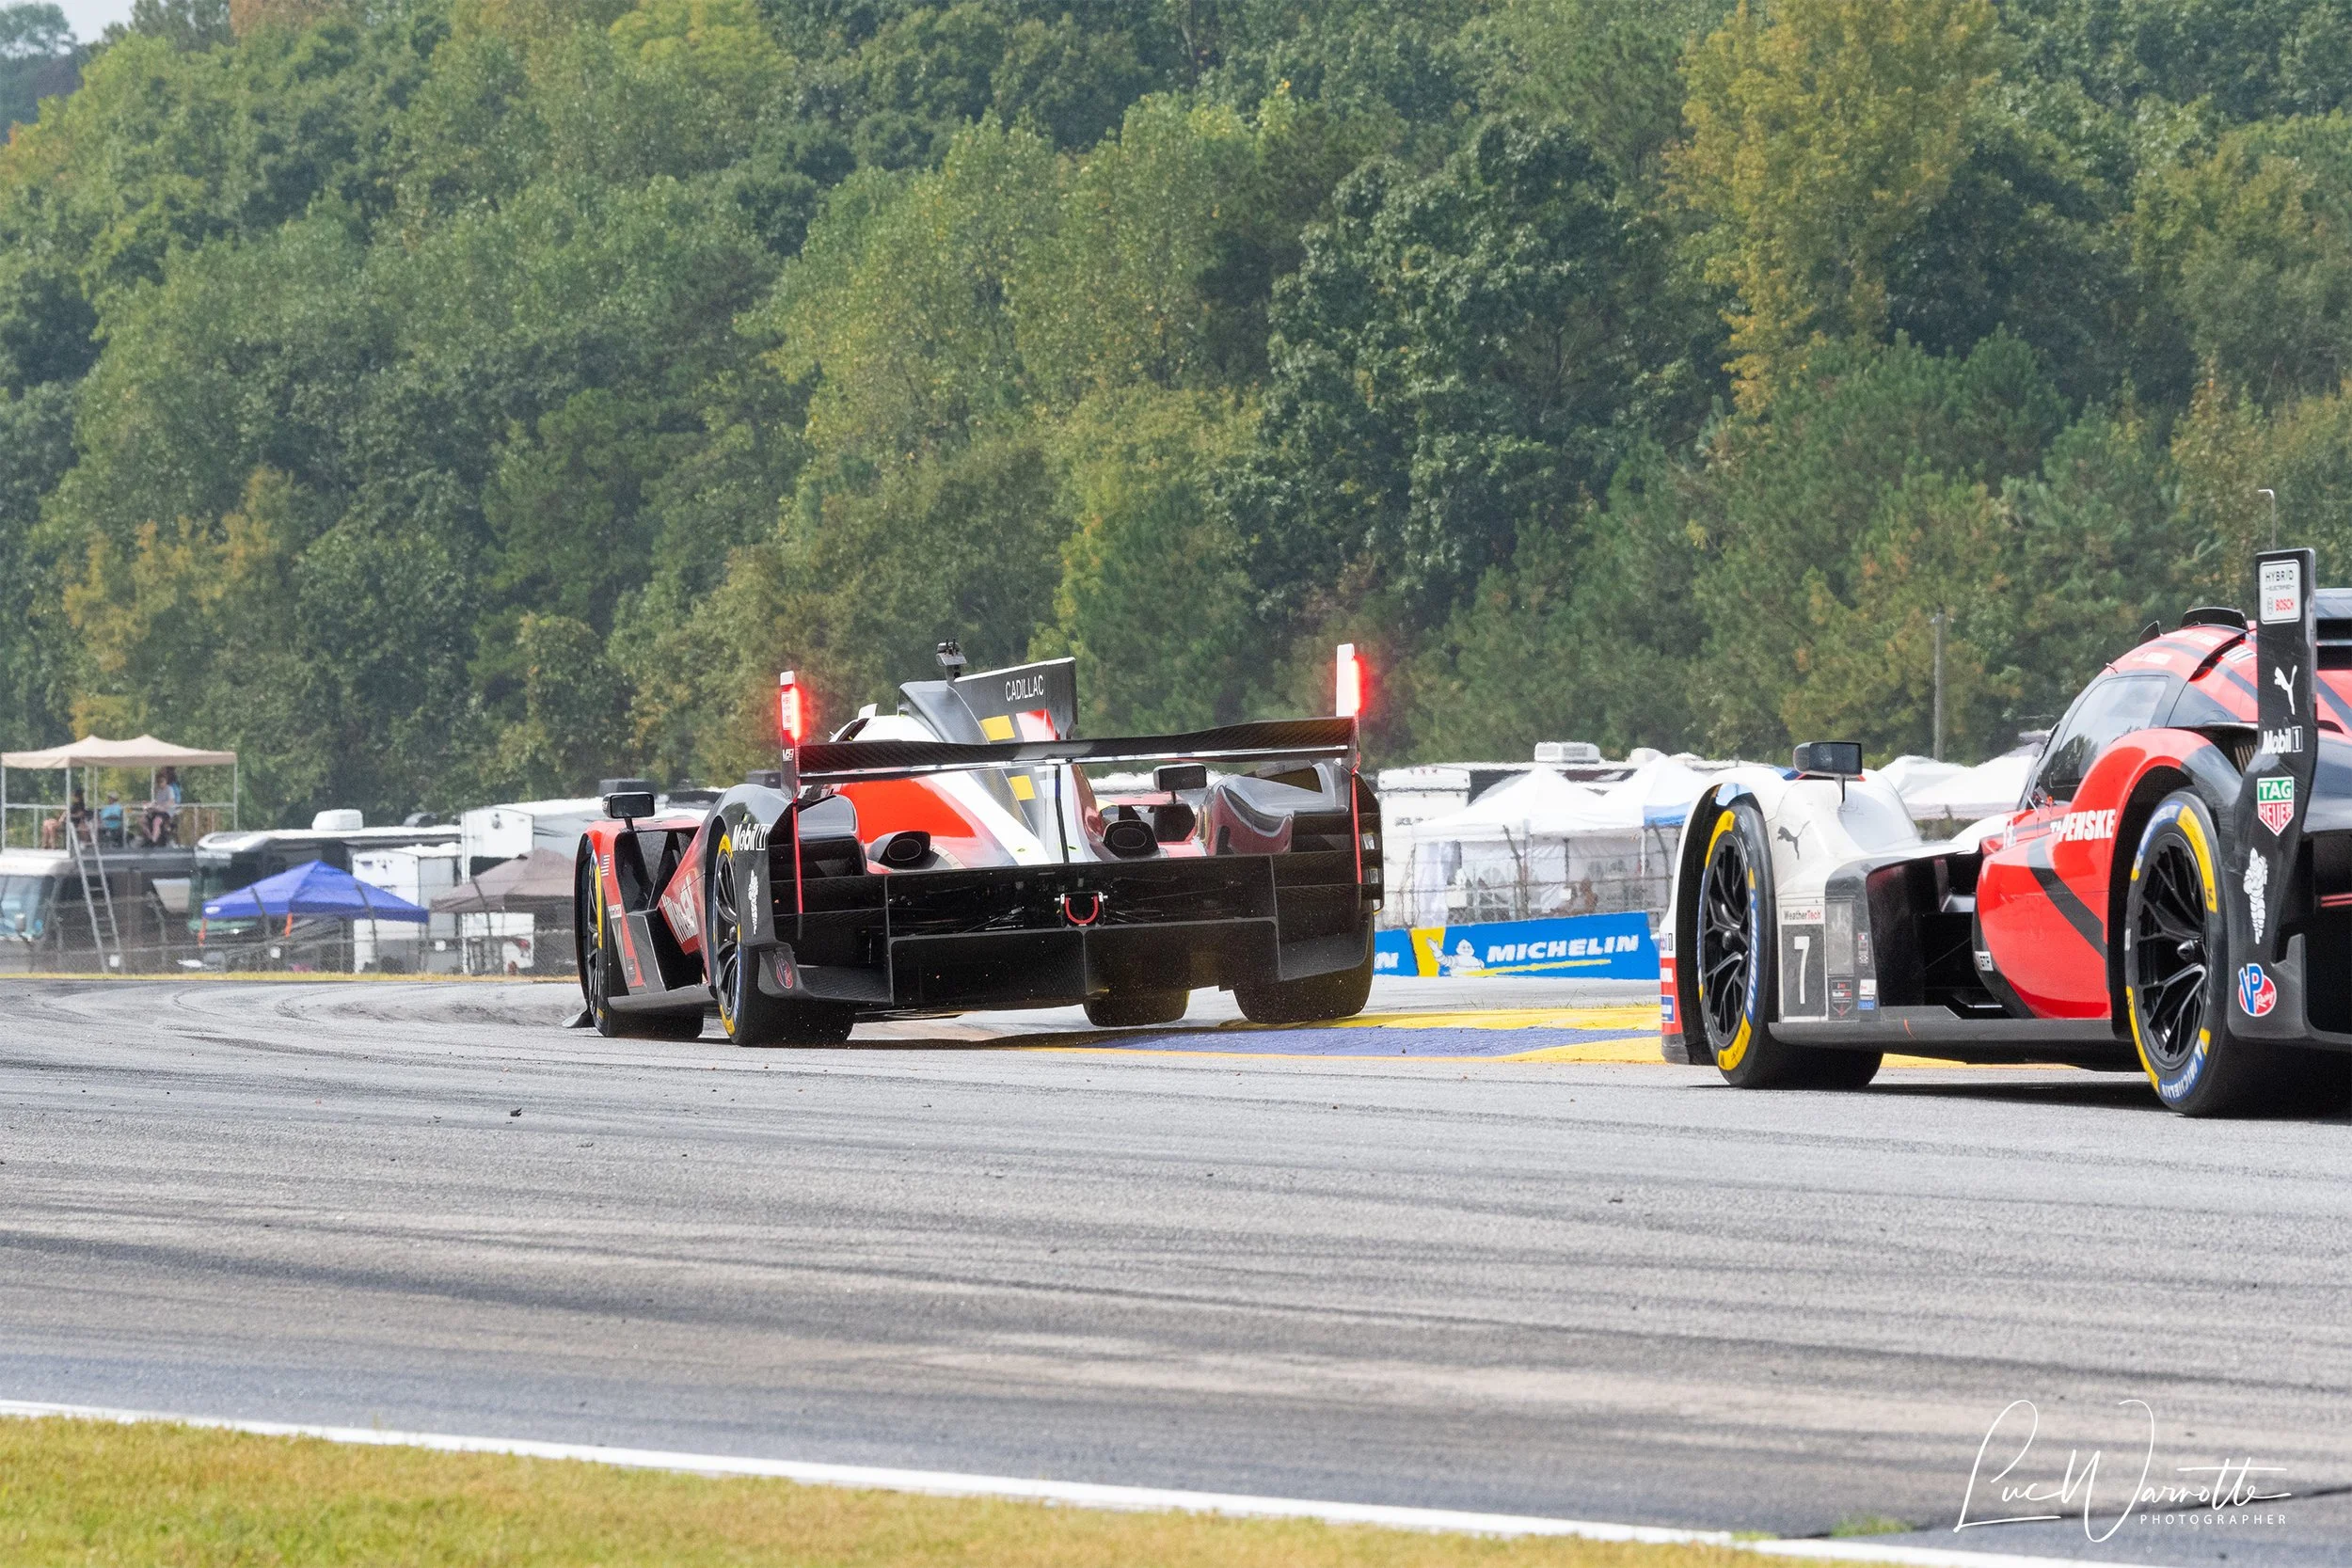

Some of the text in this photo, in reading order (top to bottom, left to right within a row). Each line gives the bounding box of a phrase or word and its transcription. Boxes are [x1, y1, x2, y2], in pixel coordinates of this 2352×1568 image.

[2265, 569, 2295, 582] HYBRID
[1005, 674, 1044, 702] CADILLAC
[2260, 727, 2292, 755] Mobil
[2259, 781, 2292, 800] TAG
[2058, 809, 2116, 842] PENSKE
[2259, 802, 2294, 832] HEUER
[732, 823, 760, 851] Mobil
[1486, 934, 1639, 963] MICHELIN
[1793, 935, 1810, 1005] 7
[2238, 962, 2264, 1015] VP
